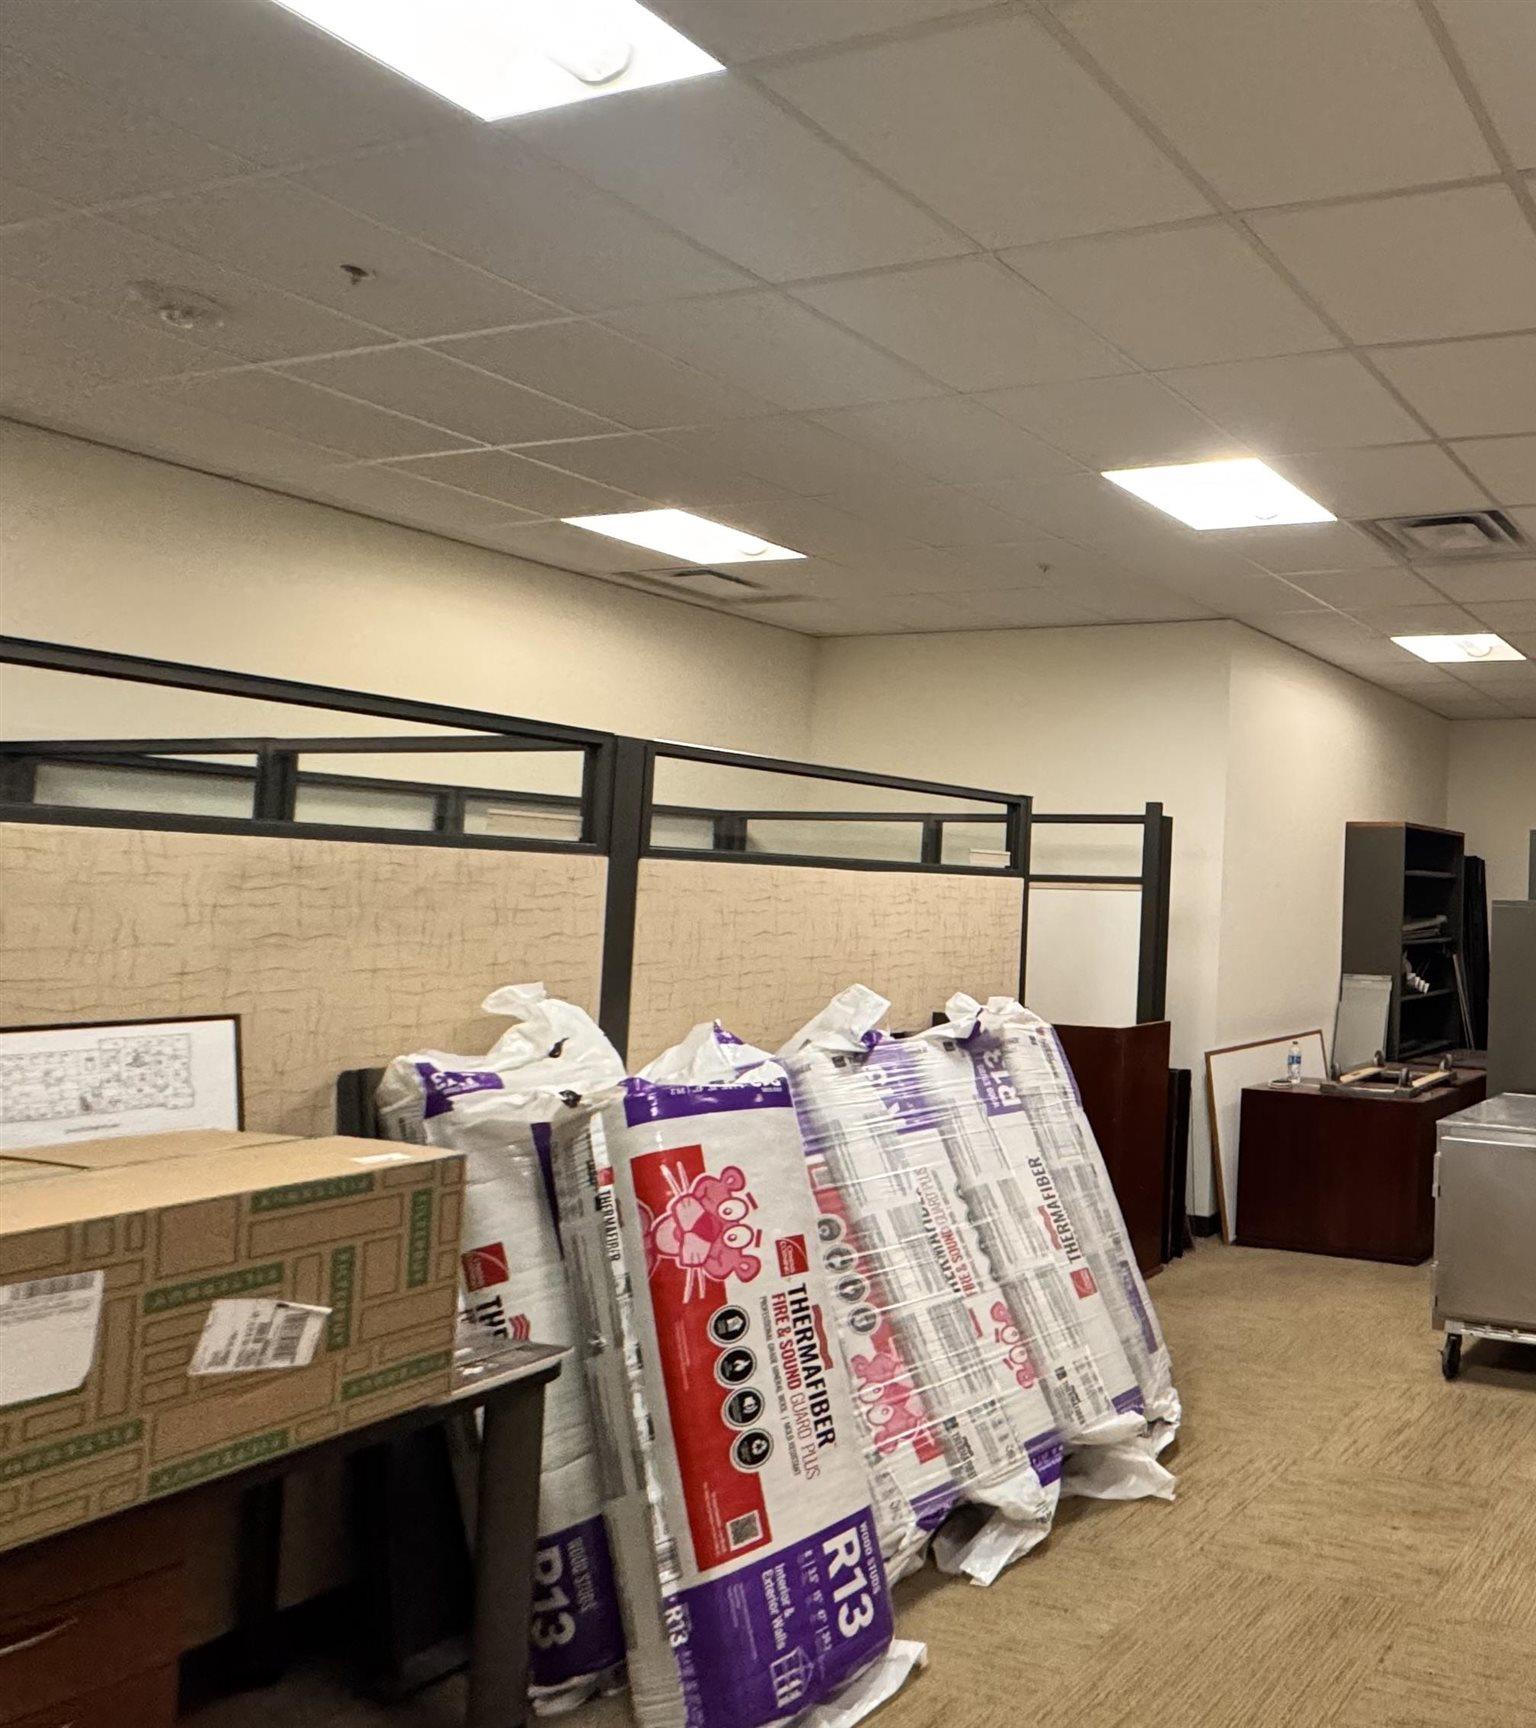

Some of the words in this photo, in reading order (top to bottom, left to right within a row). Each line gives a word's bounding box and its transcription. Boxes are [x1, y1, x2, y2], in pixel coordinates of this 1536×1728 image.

[1028, 1156, 1081, 1264] THERMAFIBER
[772, 1292, 790, 1326] FIRE
[777, 1326, 791, 1338] &
[779, 1338, 802, 1390] SOUND
[787, 1282, 836, 1449] THERMAFIBER
[790, 1392, 812, 1440] GUARD
[801, 1442, 821, 1480] PLUS
[822, 1527, 874, 1638] R13
[859, 1520, 873, 1556] WOOD
[867, 1556, 882, 1595] STUDS
[762, 1568, 779, 1616] Exterior
[772, 1615, 788, 1650] Walls
[774, 1562, 791, 1606] Interior
[783, 1606, 795, 1618] &
[664, 1604, 689, 1648] R13
